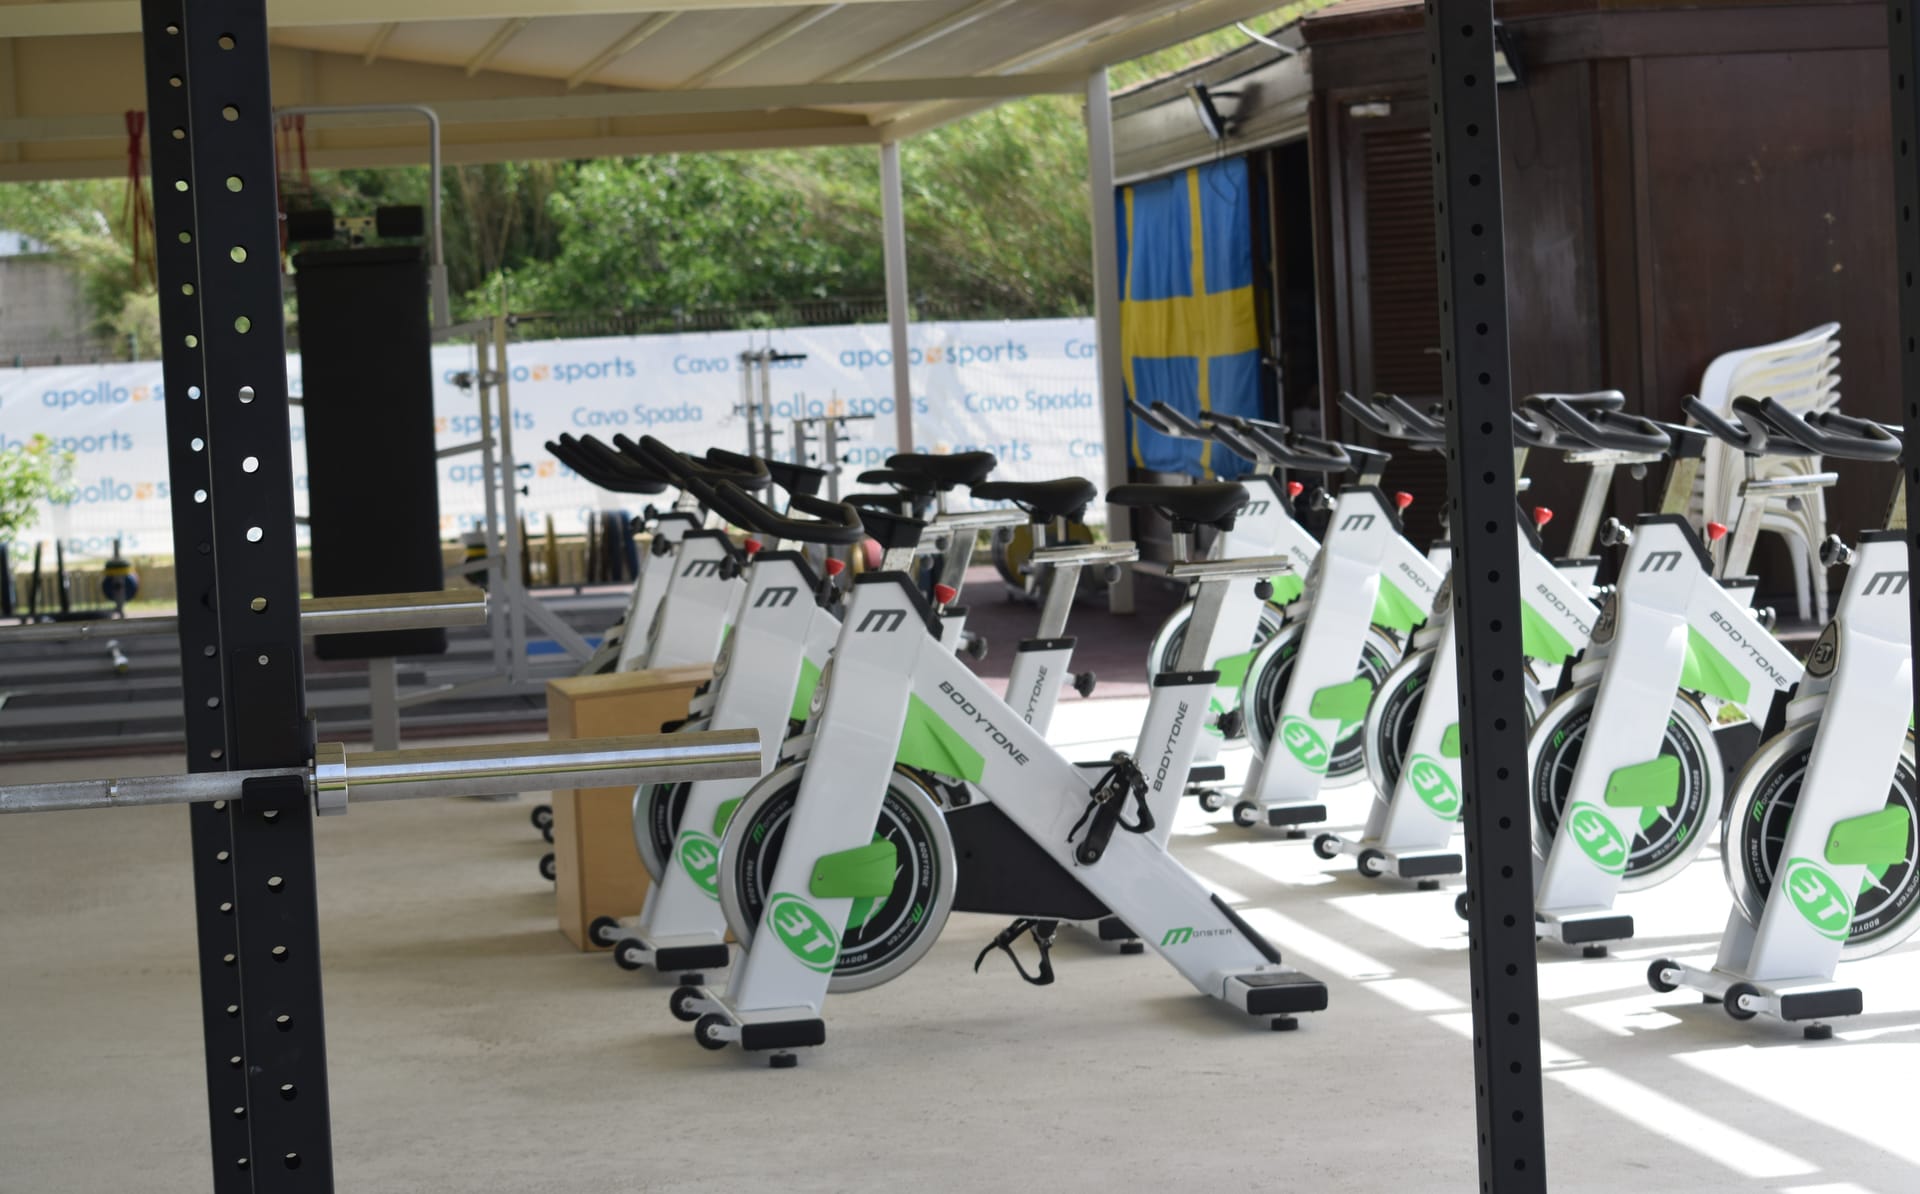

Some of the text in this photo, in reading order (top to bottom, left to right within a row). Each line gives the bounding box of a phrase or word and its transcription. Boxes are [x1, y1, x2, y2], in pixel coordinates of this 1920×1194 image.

[554, 357, 636, 383] sports
[673, 354, 729, 375] Cavo
[839, 340, 1028, 371] apoo sports
[42, 381, 129, 411] apollo
[963, 387, 1093, 413] Cavo Spada
[572, 402, 703, 427] Cavo Spada
[1399, 562, 1435, 594] BODY
[1536, 583, 1591, 637] BODYTO
[1709, 610, 1789, 687] BODYTONE
[1023, 665, 1049, 725] DYTONE
[938, 680, 1030, 767] BODYTONE
[1153, 700, 1189, 793] BODYTONE
